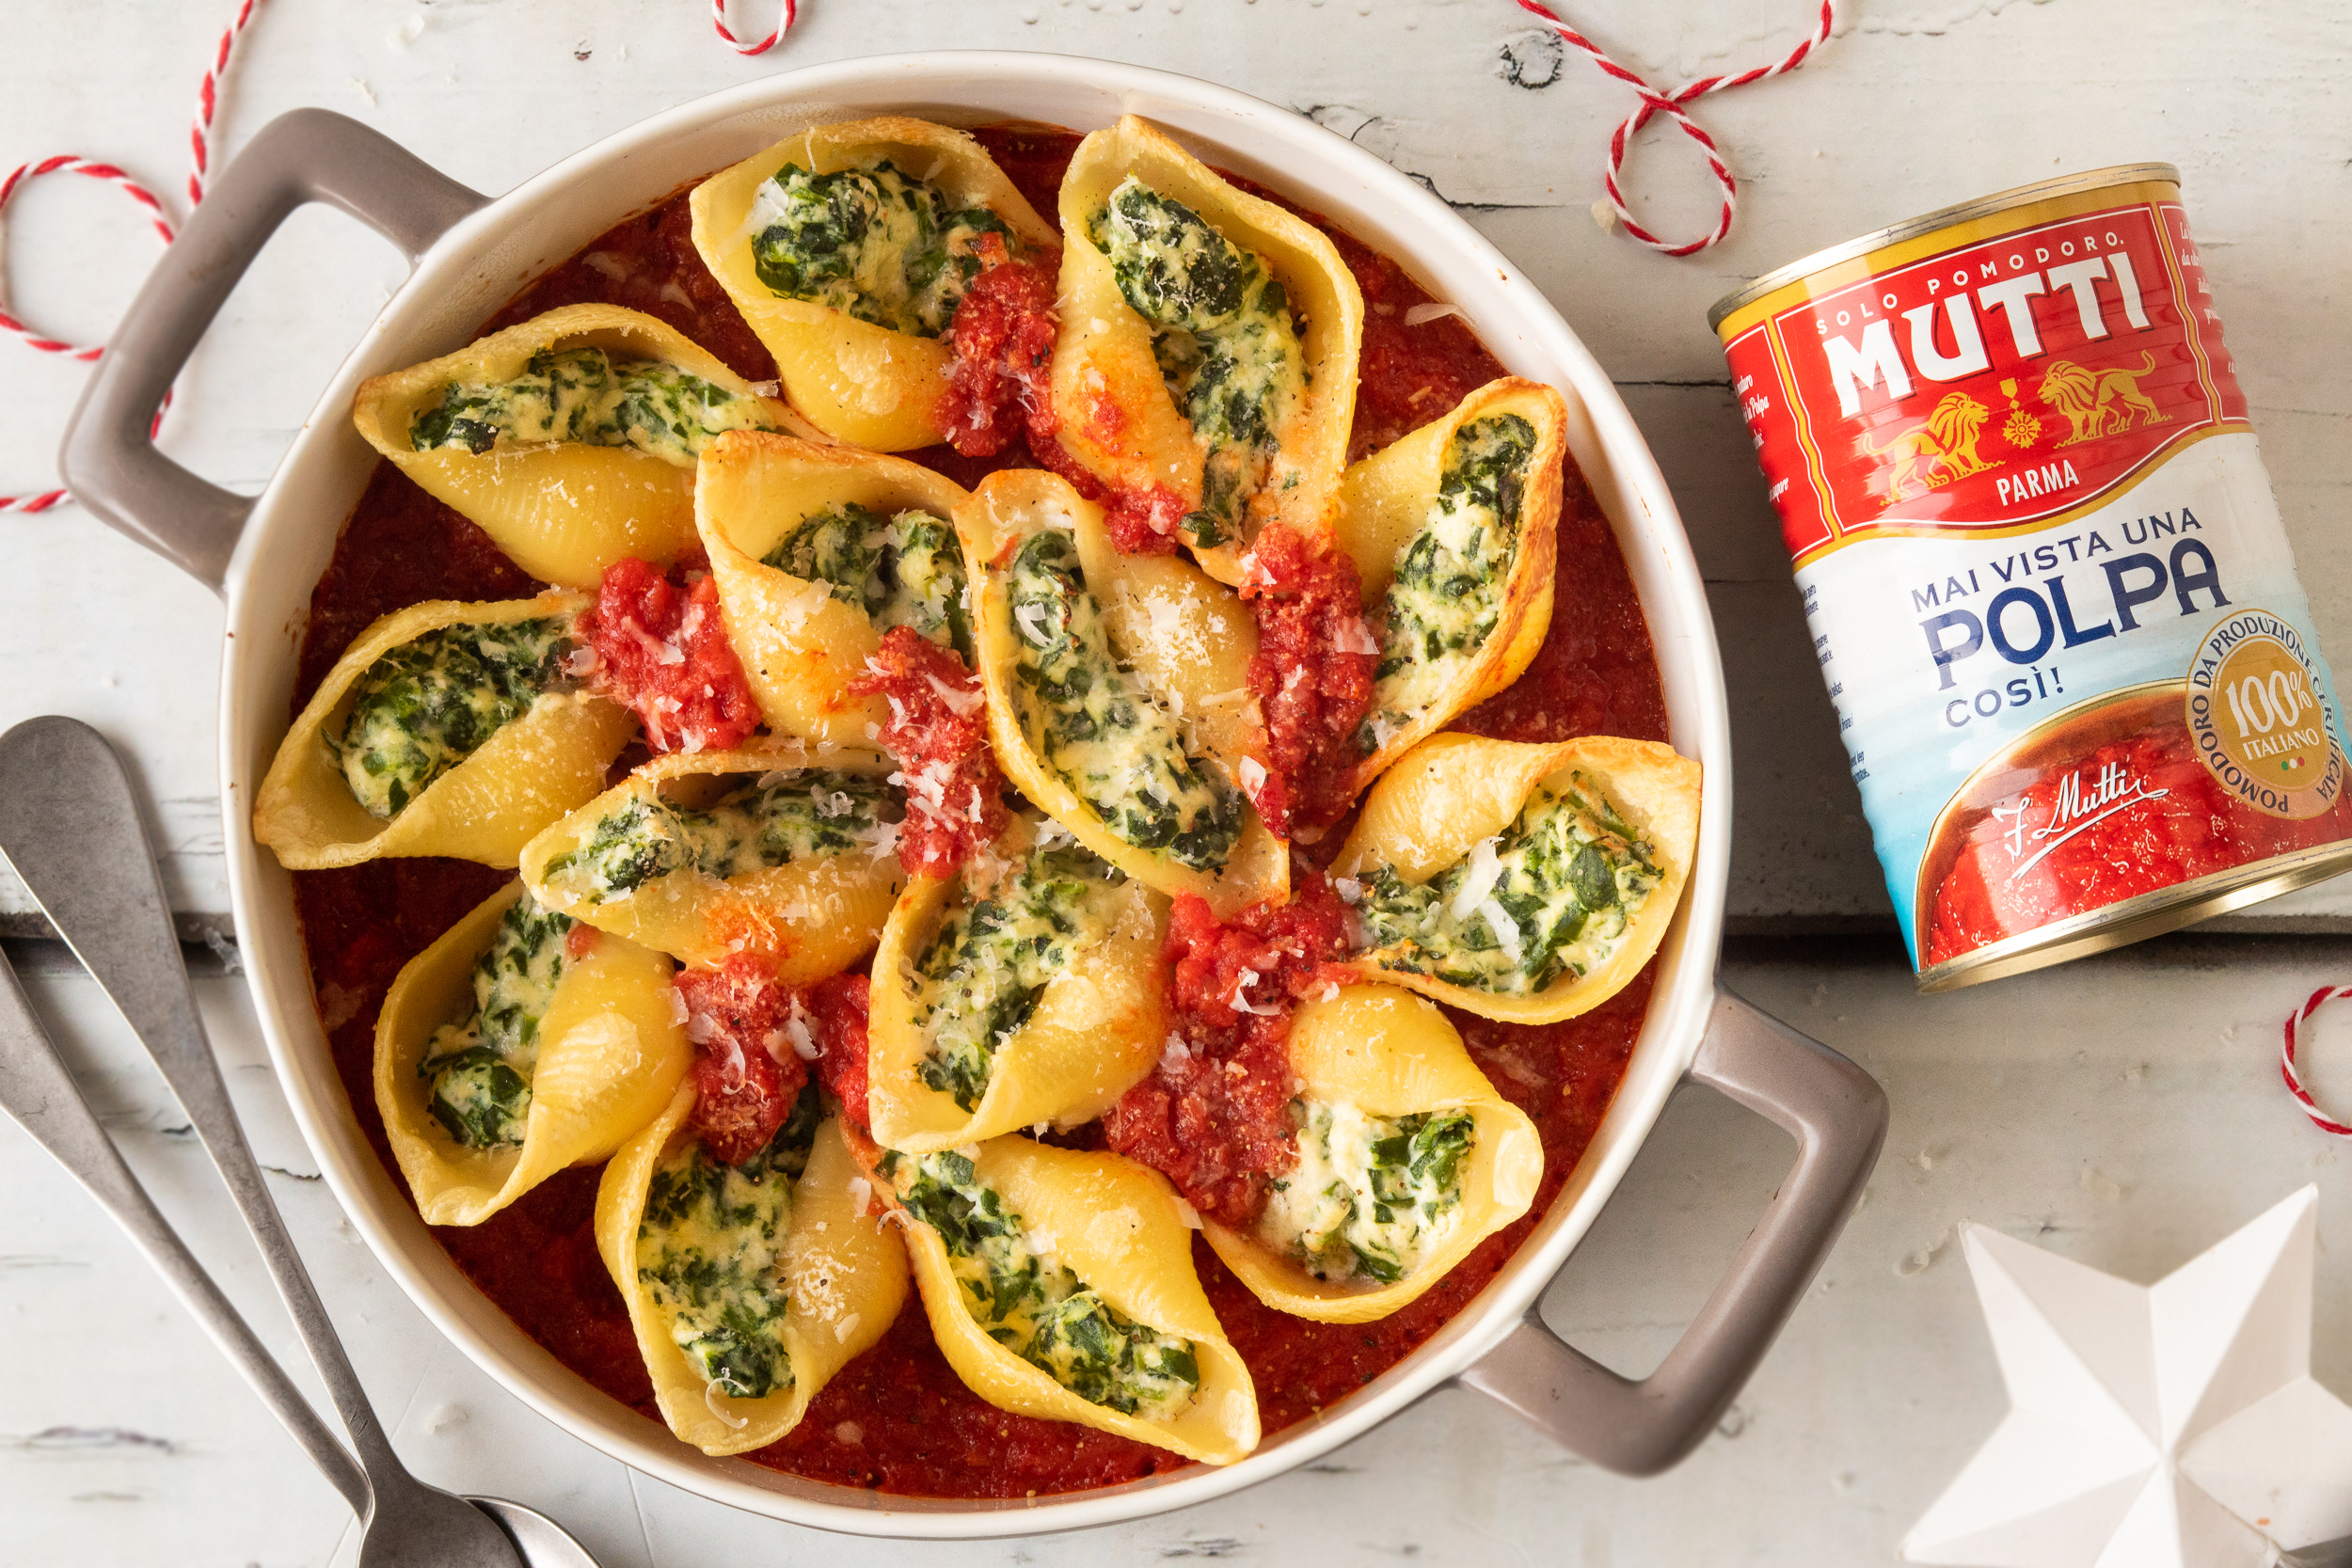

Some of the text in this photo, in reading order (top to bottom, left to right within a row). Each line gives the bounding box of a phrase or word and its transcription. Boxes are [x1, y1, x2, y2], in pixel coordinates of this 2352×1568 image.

[1816, 293, 1898, 335] SOLO
[1822, 251, 2153, 420] MUTTI
[1996, 459, 2079, 506] PARMA
[1910, 507, 2202, 612] MAI VISTA UNA
[1918, 537, 2232, 691] POLPA
[1946, 665, 2064, 728] COSÌ!
[2192, 617, 2341, 813] POMODORO DA PRODUZIONE CERTIFICATA
[2225, 670, 2312, 738] 100%
[2242, 728, 2319, 761] ITALIANO
[2031, 762, 2169, 840] Mutti
